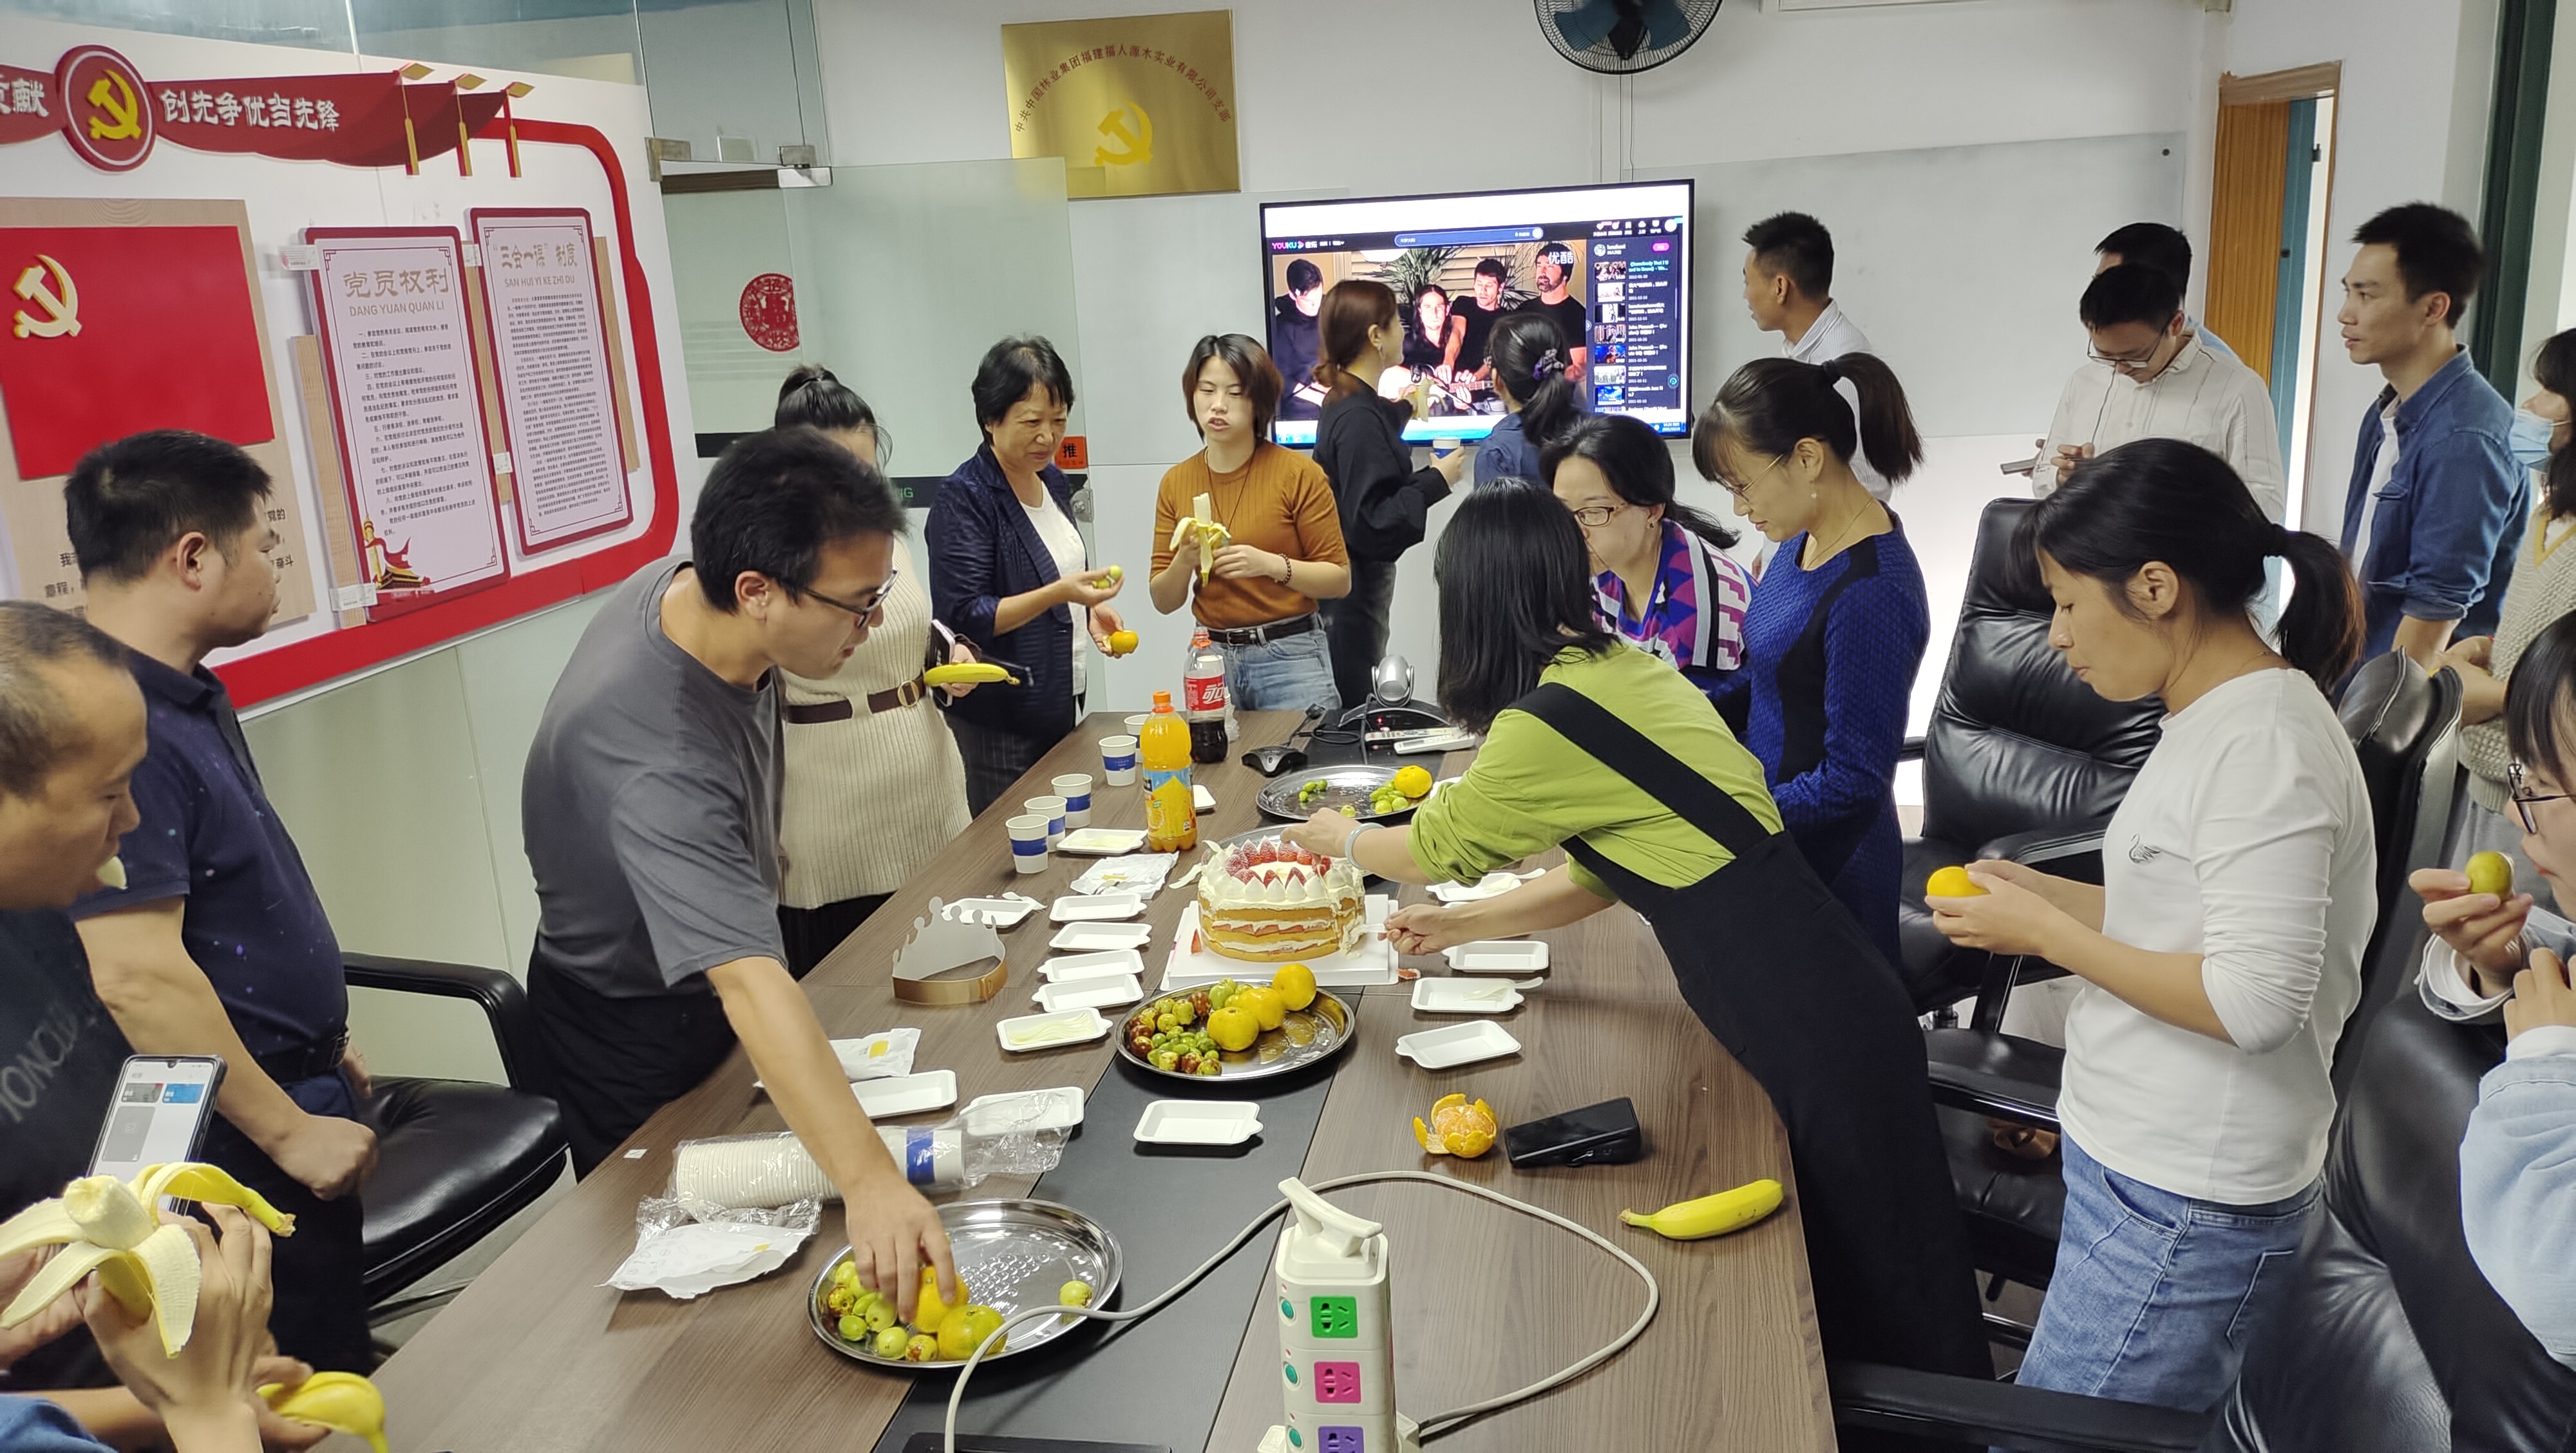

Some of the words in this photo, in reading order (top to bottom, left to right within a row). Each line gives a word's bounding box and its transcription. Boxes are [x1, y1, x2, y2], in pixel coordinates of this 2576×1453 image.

[158, 89, 340, 133] 创先争优当先锋
[1548, 251, 1573, 265] 优酷
[343, 267, 449, 298] 党员权利
[505, 277, 521, 288] SAN
[522, 276, 534, 287] HUI
[536, 276, 542, 286] YI
[544, 276, 553, 285] KE
[553, 276, 564, 285] ZHI
[565, 275, 574, 283] DU
[350, 305, 378, 317] DANG
[380, 303, 406, 314] YUAN
[408, 301, 435, 313] QUAN
[437, 301, 444, 310] LI
[1063, 443, 1077, 458] 推
